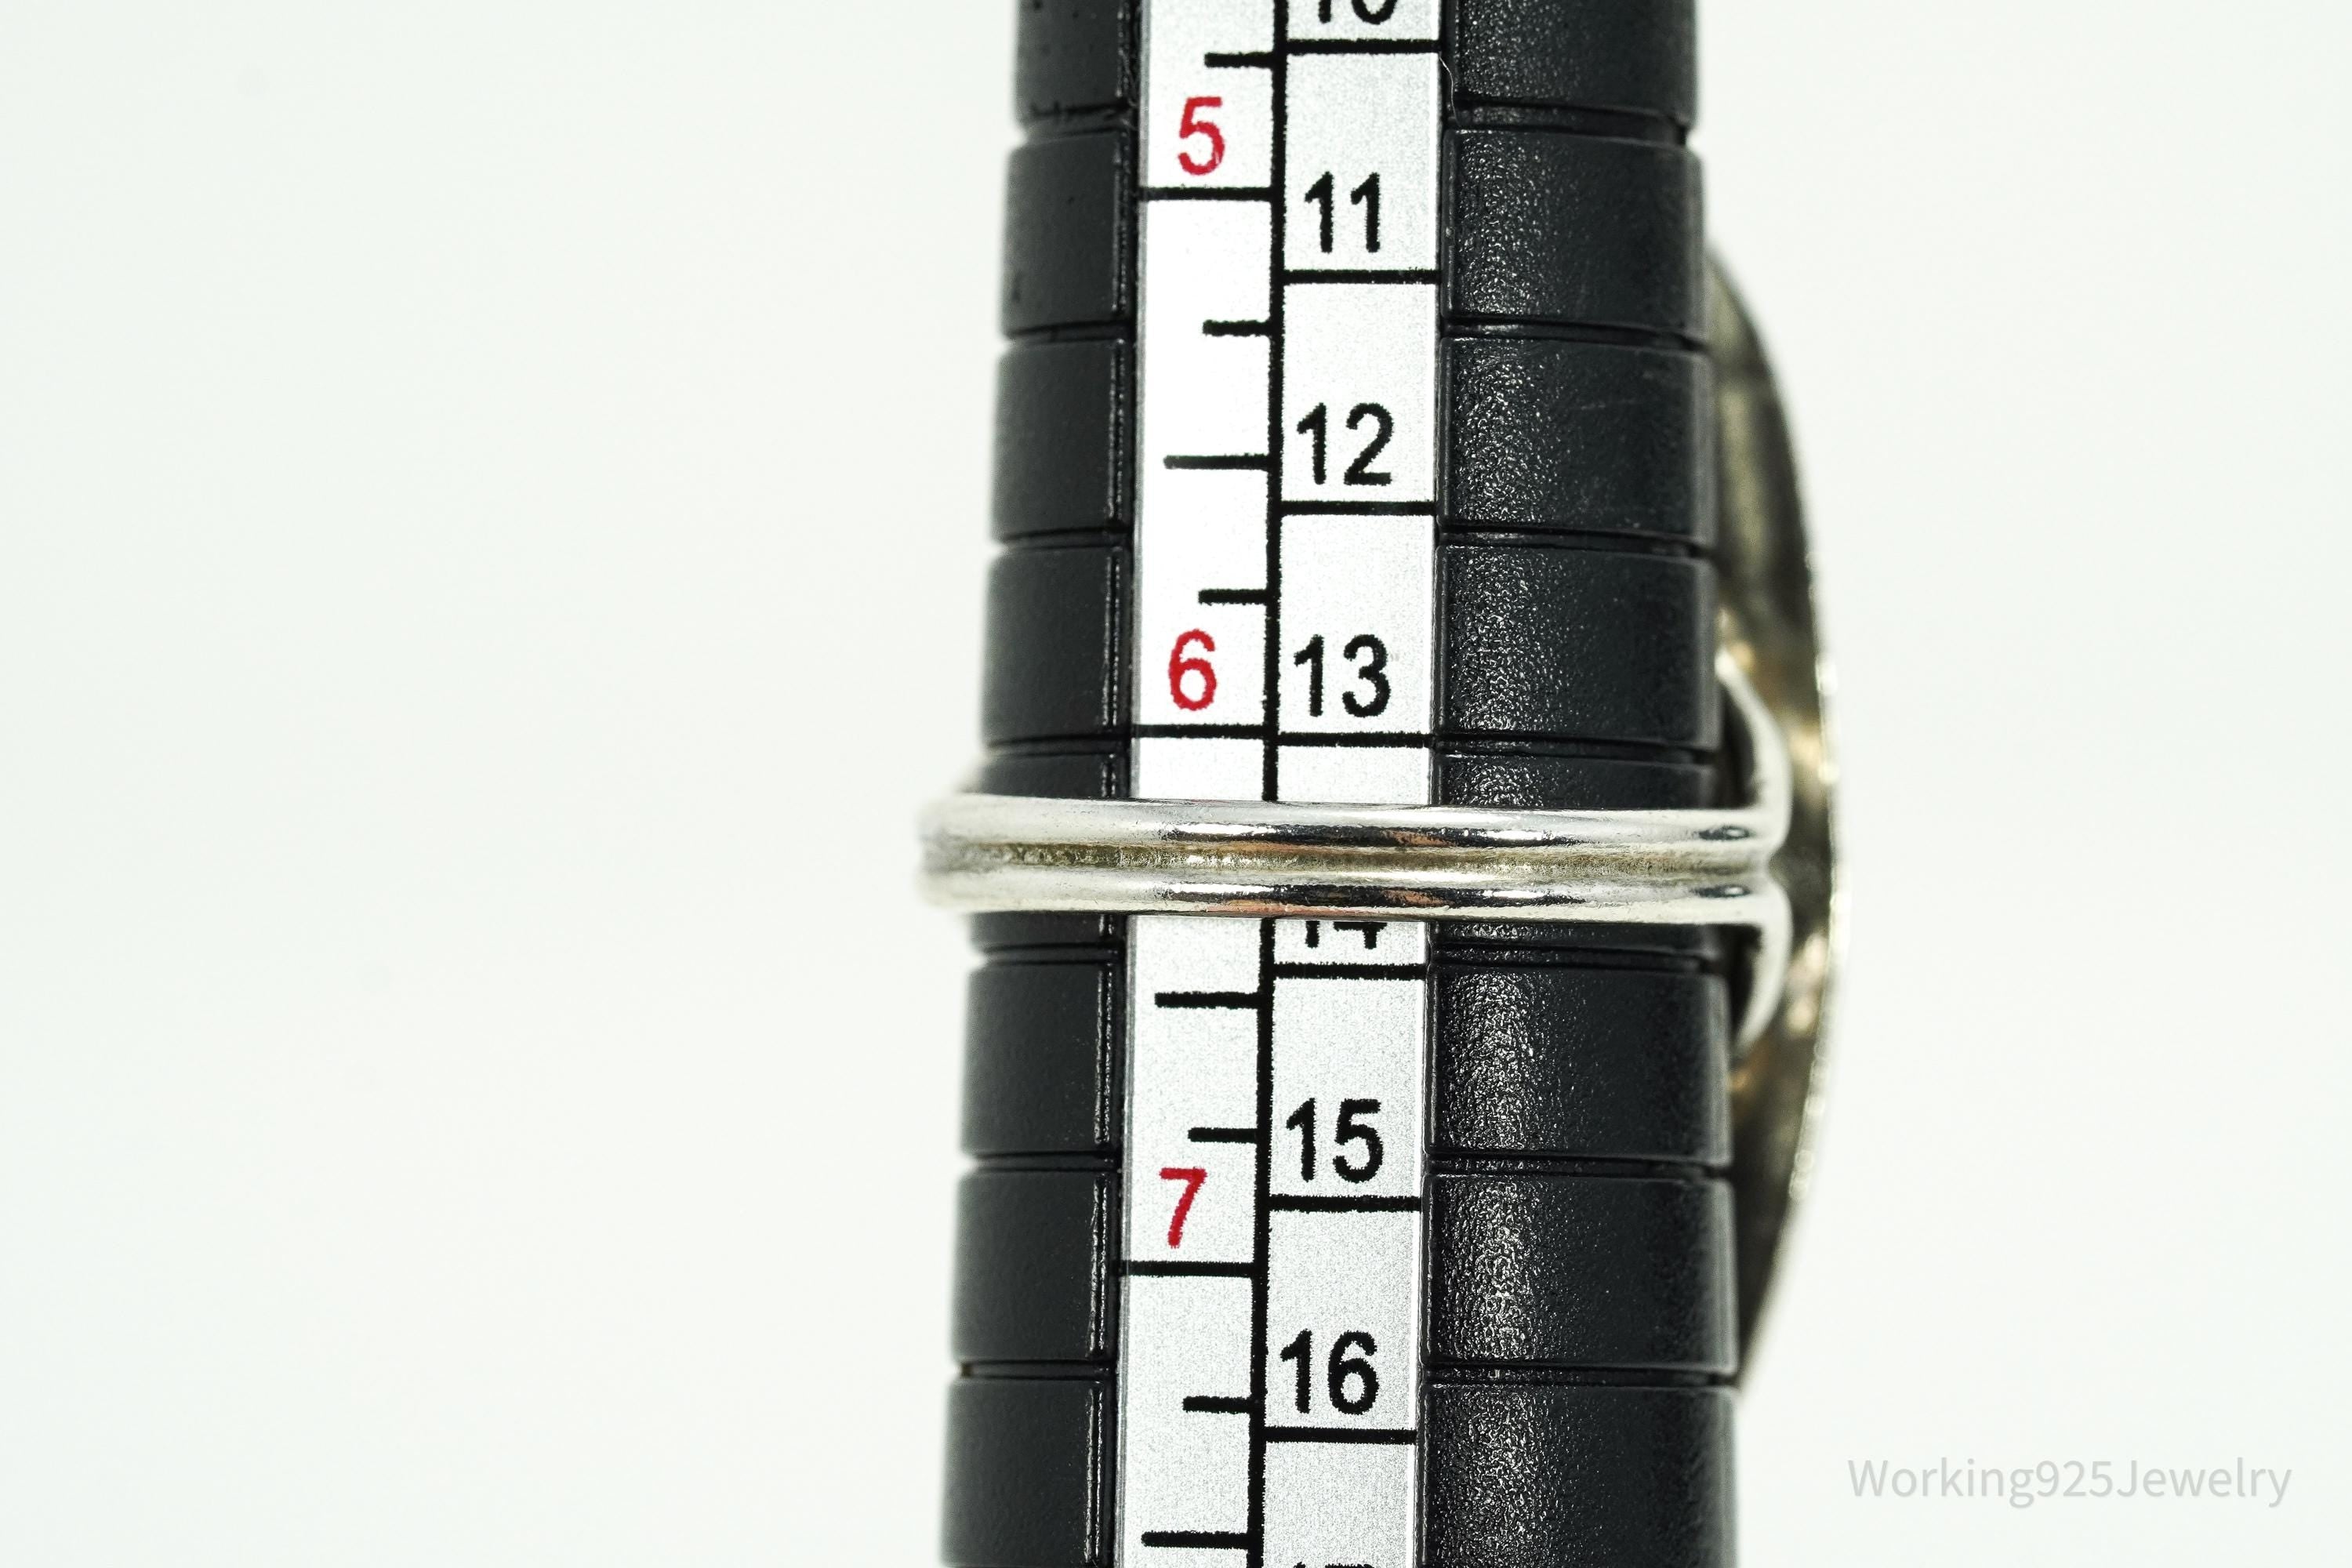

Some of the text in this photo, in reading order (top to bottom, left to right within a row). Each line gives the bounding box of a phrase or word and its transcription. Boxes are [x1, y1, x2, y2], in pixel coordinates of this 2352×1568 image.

[1178, 96, 1225, 176] 5
[1304, 171, 1381, 253] 11
[1296, 402, 1394, 487] 12
[1168, 629, 1217, 712] 6
[1293, 633, 1392, 718] 13
[1286, 1098, 1384, 1184] 15
[1159, 1167, 1207, 1248] 7
[1280, 1328, 1380, 1415] 16
